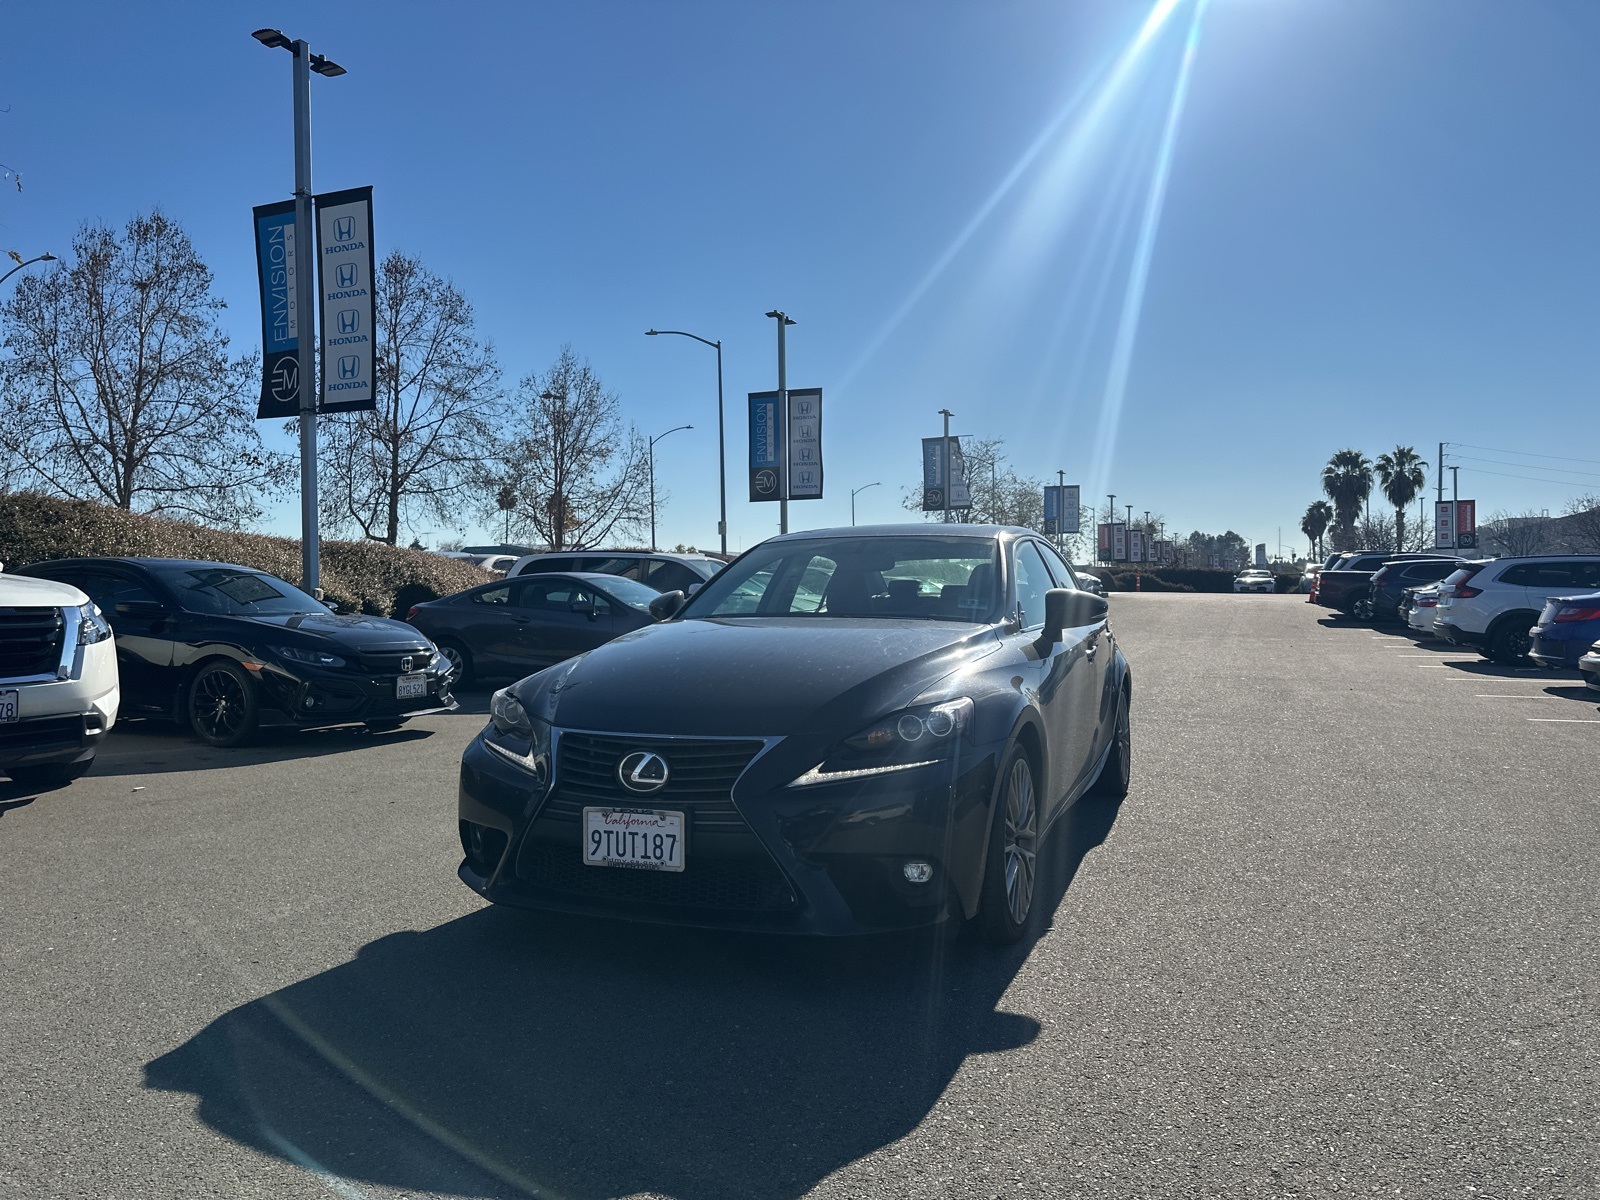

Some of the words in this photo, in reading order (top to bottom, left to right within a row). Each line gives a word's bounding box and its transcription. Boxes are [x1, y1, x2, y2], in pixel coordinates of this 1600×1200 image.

[325, 241, 365, 254] HONDA
[268, 225, 288, 342] ENVISION
[287, 234, 296, 329] MOTORS
[327, 288, 367, 300] HONDA
[328, 334, 368, 346] HONDA
[328, 380, 368, 391] HONDA
[756, 403, 767, 463] ENVISION
[399, 684, 424, 696] 8YGL521
[604, 812, 666, 829] California
[590, 829, 677, 862] 9TUT187
